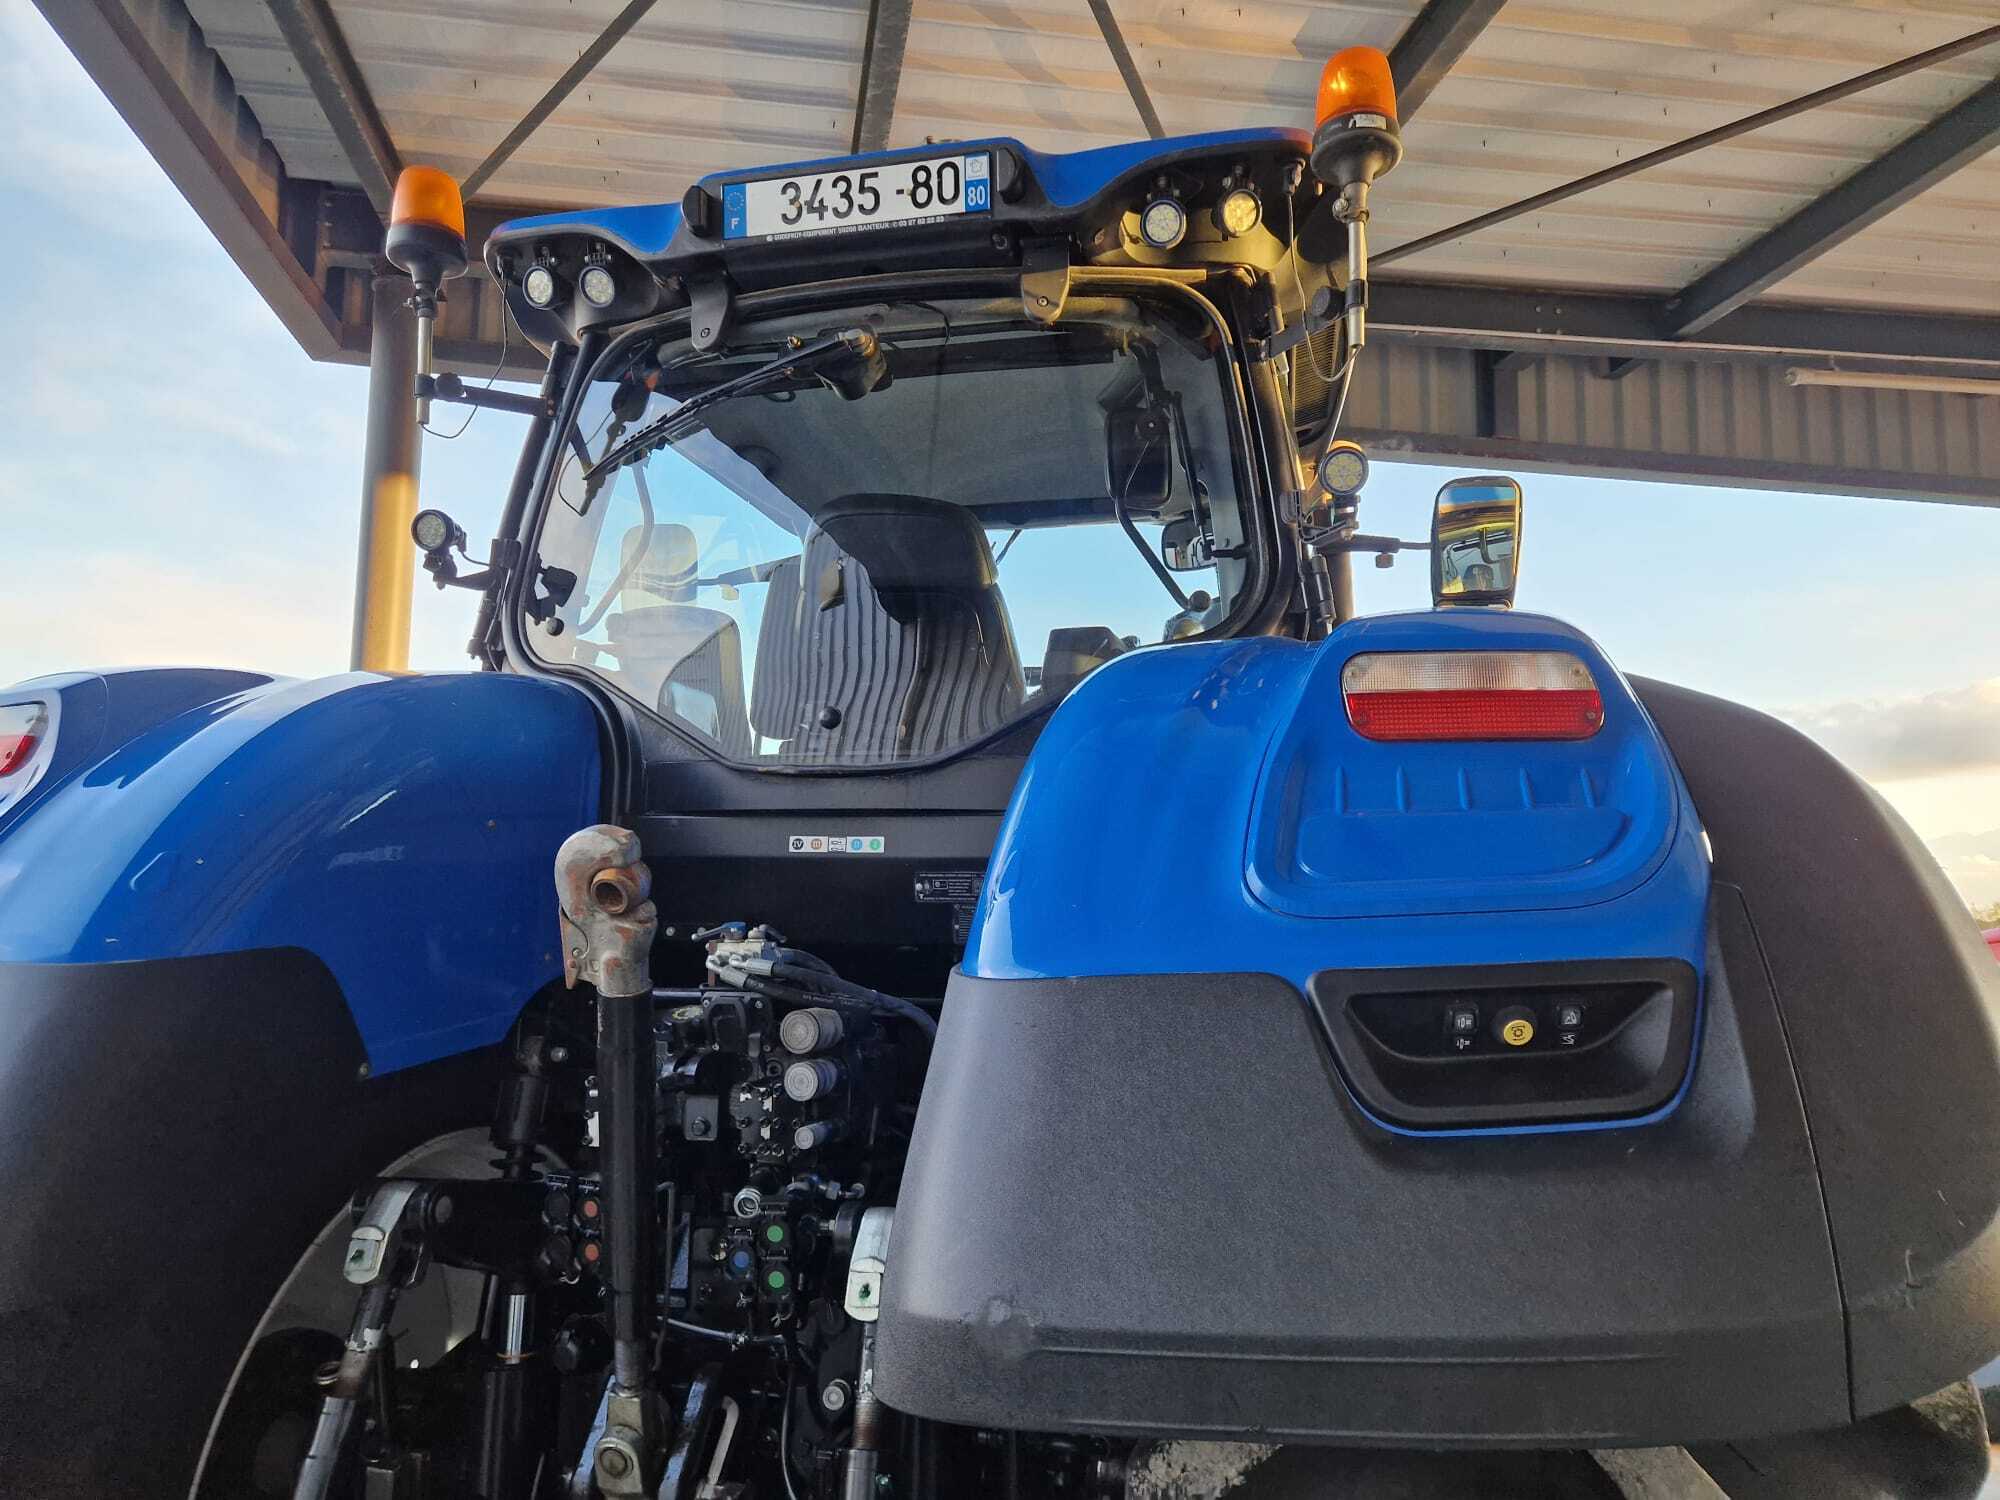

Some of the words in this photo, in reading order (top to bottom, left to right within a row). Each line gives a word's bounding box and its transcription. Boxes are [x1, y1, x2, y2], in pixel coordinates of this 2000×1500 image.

[781, 172, 880, 225] 3435
[967, 184, 986, 206] 80
[731, 217, 740, 230] F
